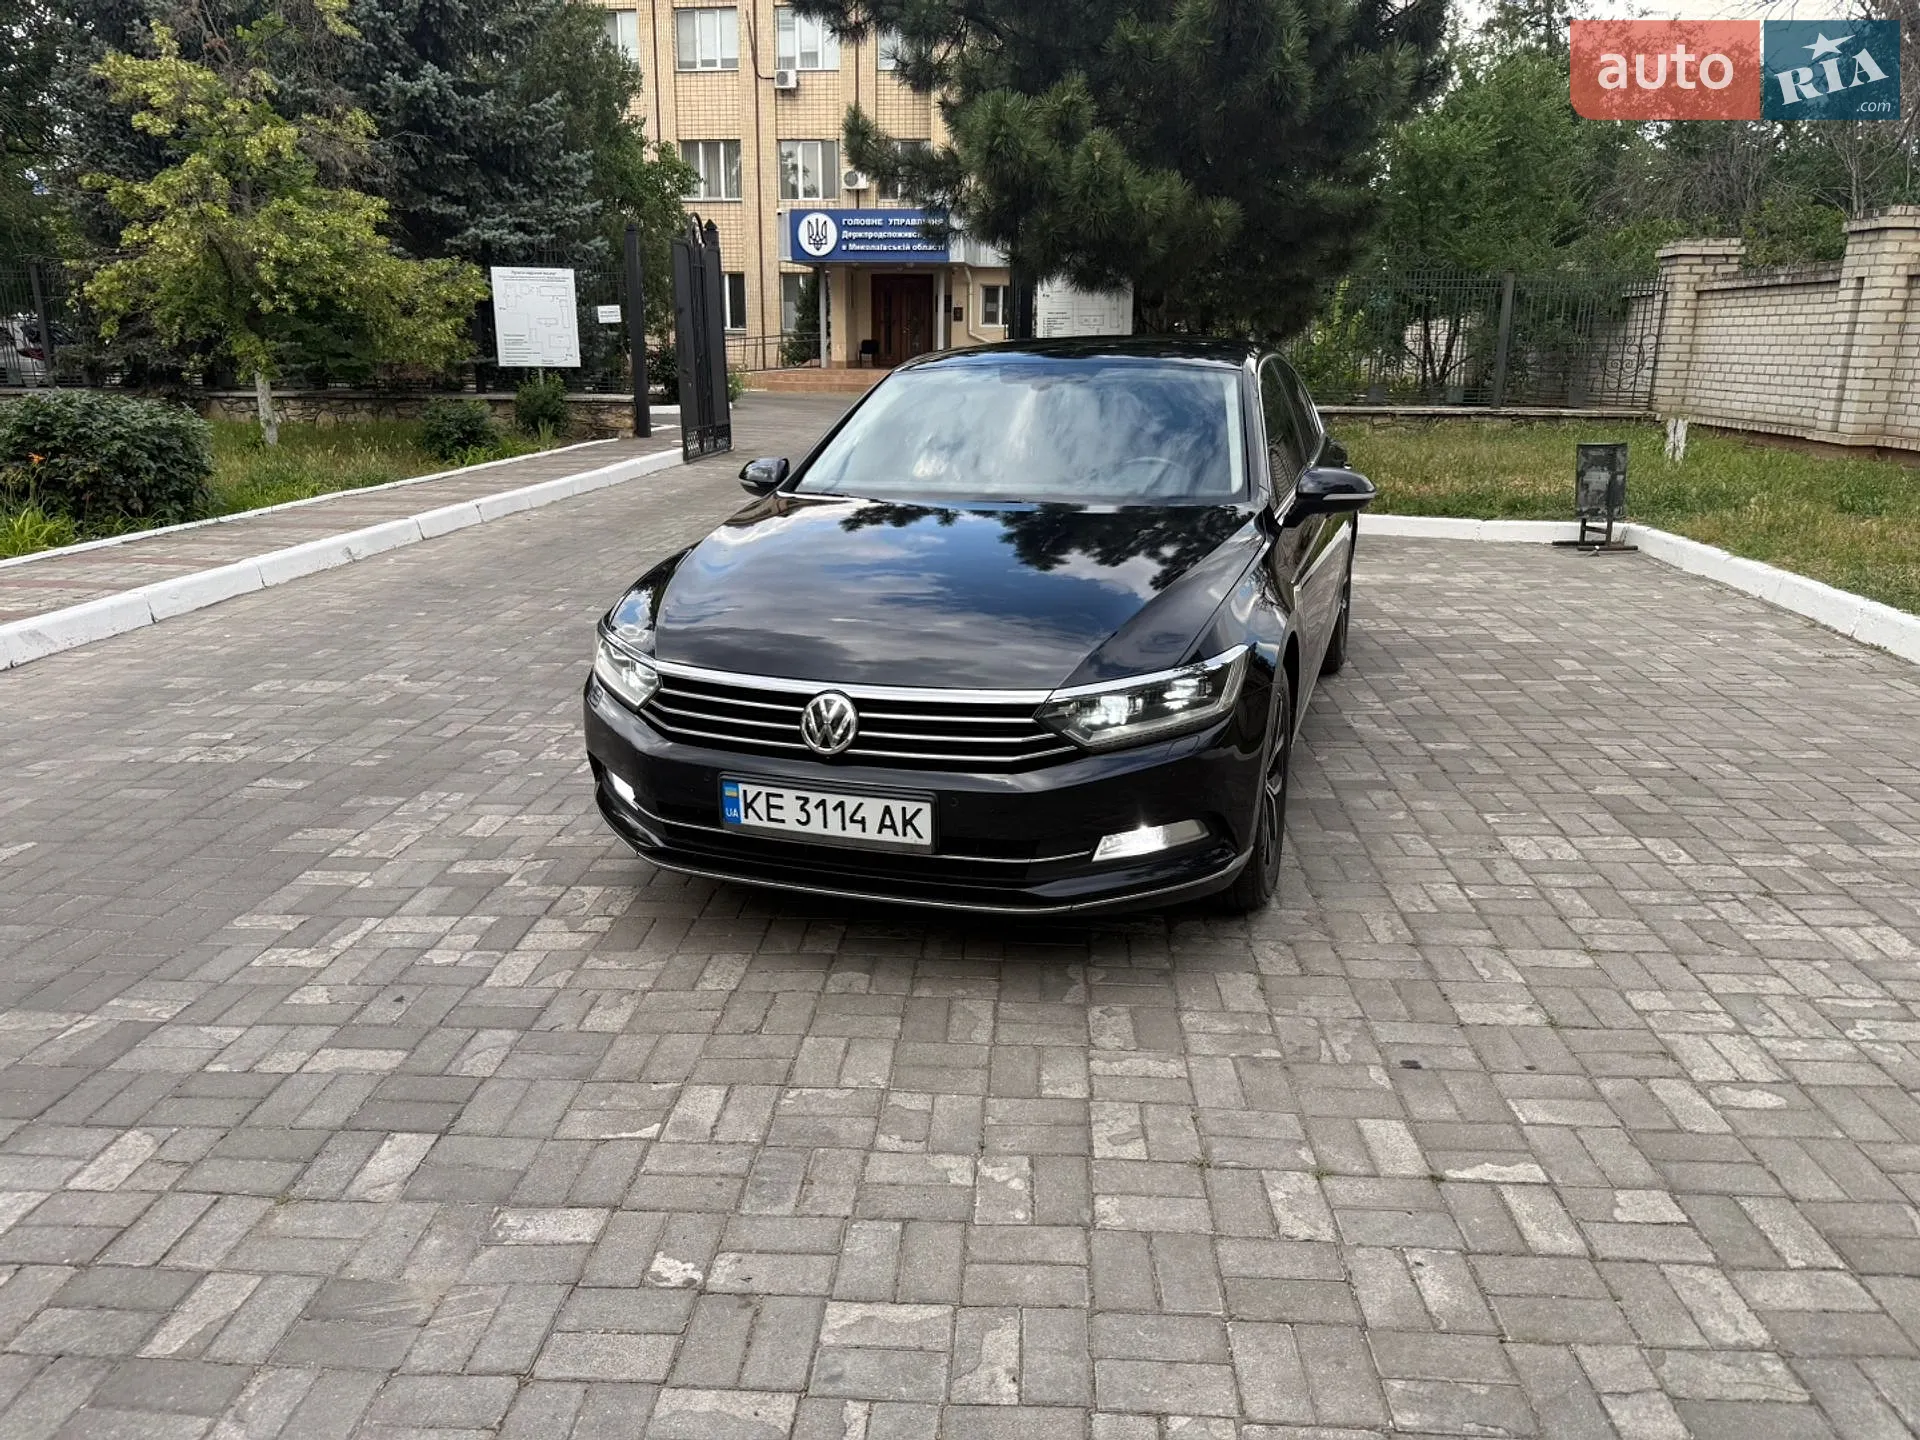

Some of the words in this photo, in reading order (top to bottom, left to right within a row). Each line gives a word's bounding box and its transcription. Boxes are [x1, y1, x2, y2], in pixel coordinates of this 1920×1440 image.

[842, 218, 883, 226] ГОЛОВНЕ
[848, 243, 910, 251] Миколаївській
[725, 808, 739, 818] UA
[742, 788, 786, 824] KE
[795, 796, 867, 833] 3114
[876, 805, 924, 839] AK
